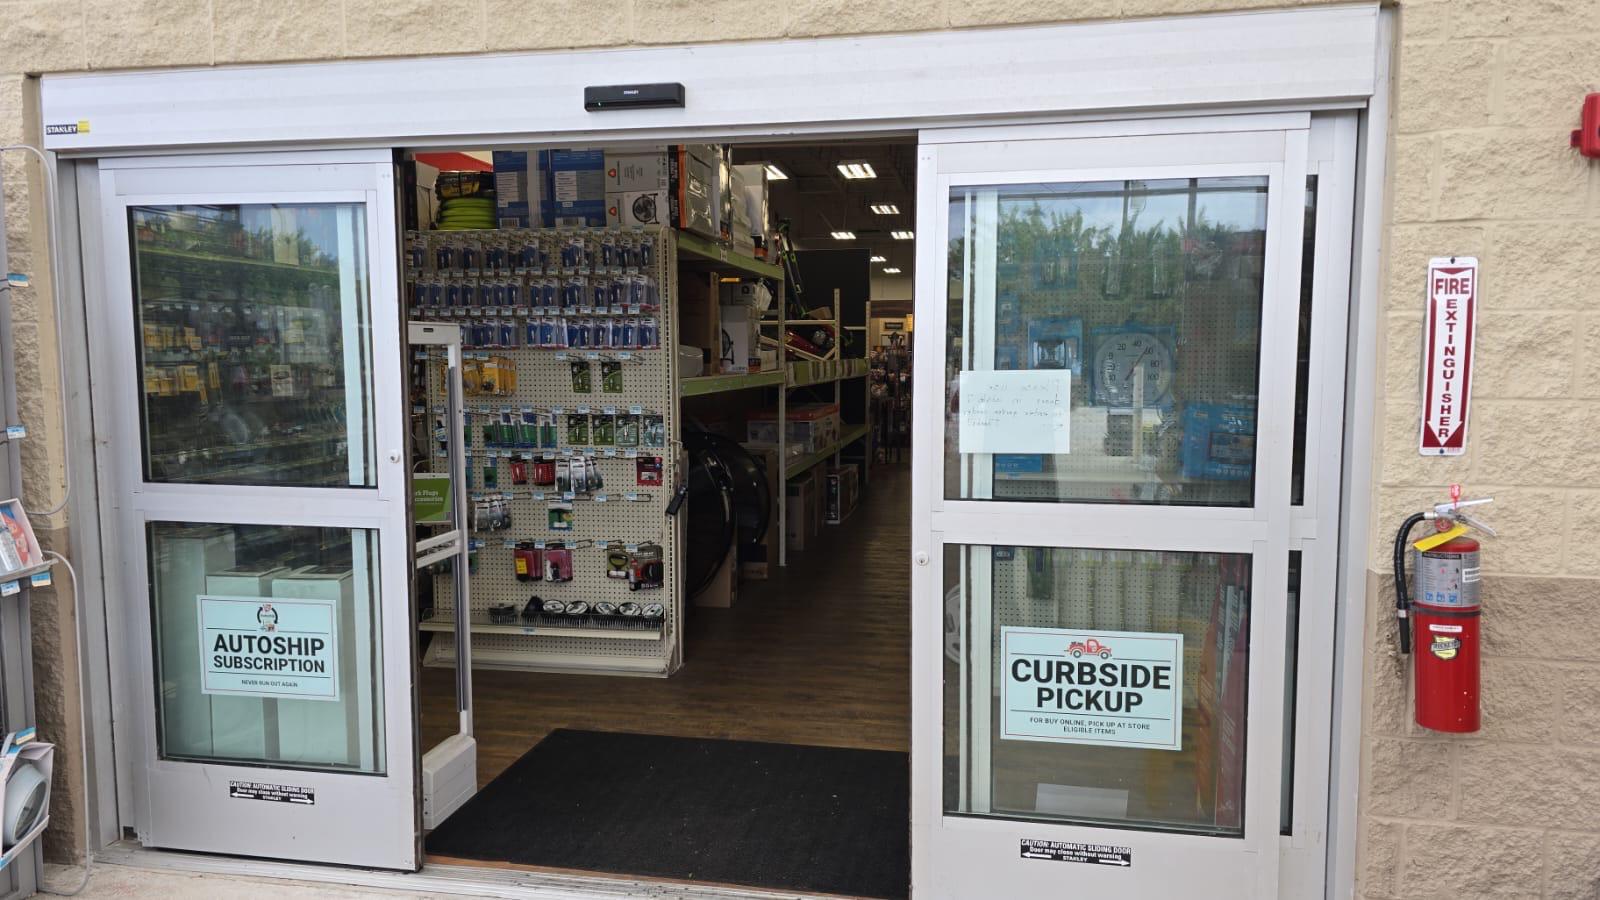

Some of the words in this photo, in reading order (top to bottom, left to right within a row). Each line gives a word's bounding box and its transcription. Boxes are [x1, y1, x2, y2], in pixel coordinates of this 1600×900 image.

[47, 125, 77, 134] STANLEY
[1435, 278, 1470, 295] FIRE
[1438, 298, 1458, 438] EXTINGUISHER
[213, 633, 325, 656] AUTOSHIP
[213, 655, 325, 673] SUBSCRIPTION
[1011, 658, 1171, 690] CURBSIDE
[1036, 687, 1143, 713] PICKUP
[1060, 719, 1087, 727] ONLINE,
[1063, 725, 1092, 734] ELIGIBLE
[1094, 727, 1116, 735] ITEMS
[253, 783, 280, 791] AUTOMATIC
[1050, 841, 1086, 851] AUTOMATIC
[1087, 844, 1112, 853] SLIDING
[1113, 846, 1131, 855] DOOR
[1074, 850, 1097, 858] without
